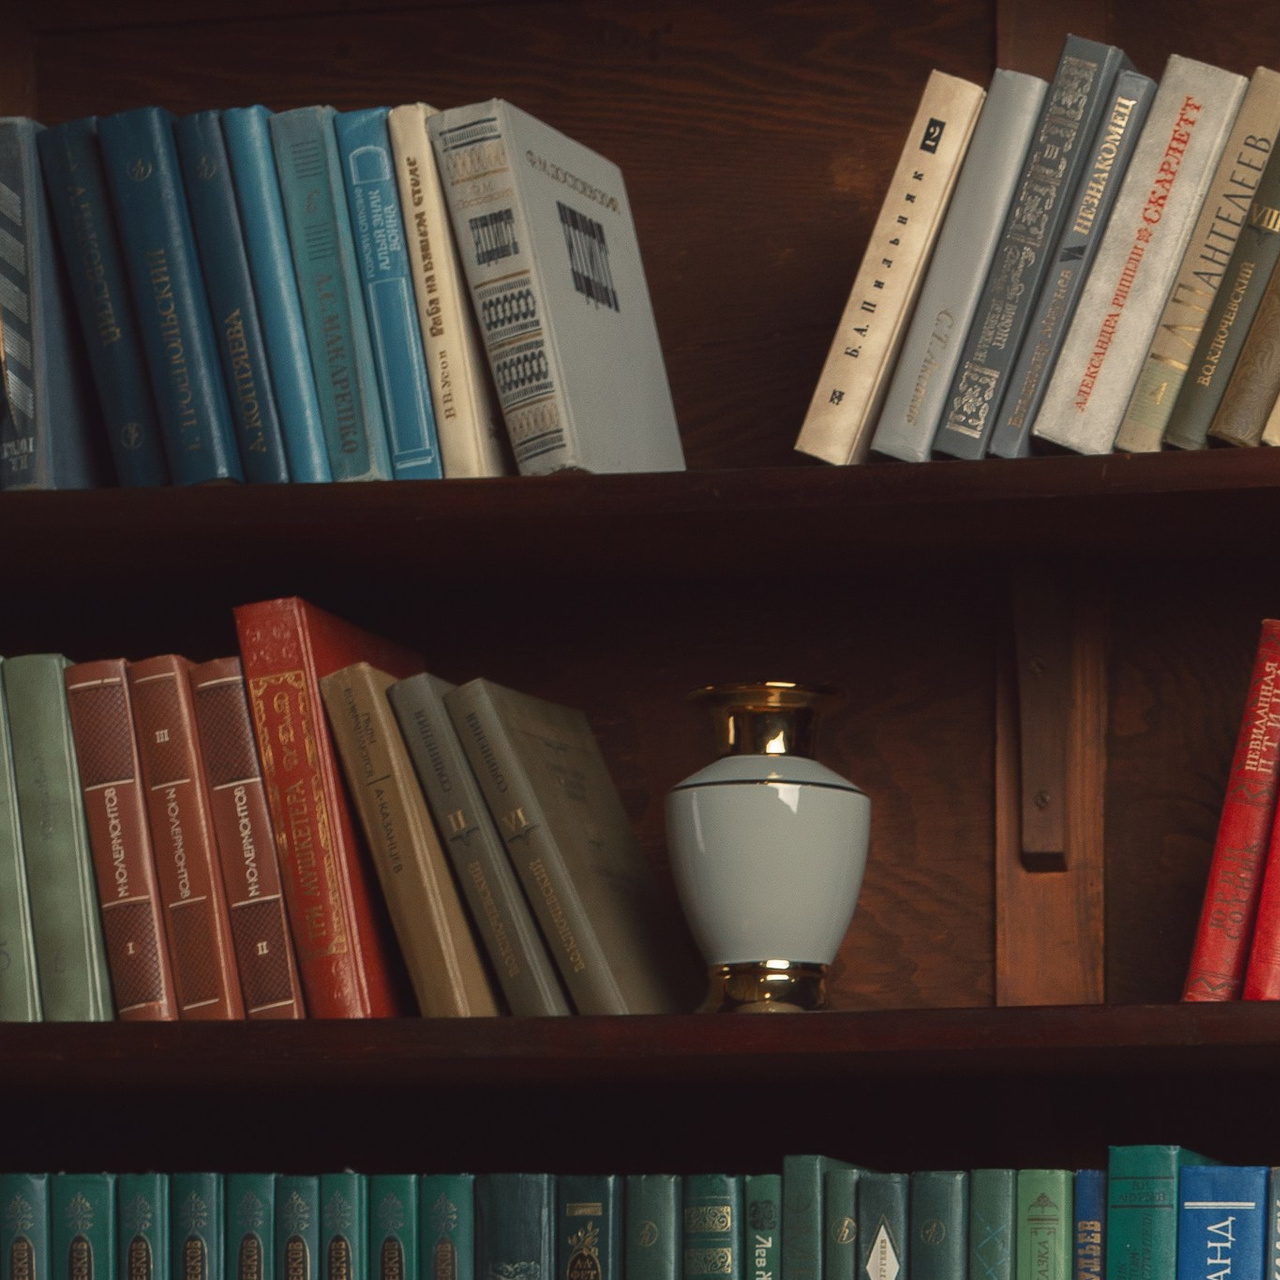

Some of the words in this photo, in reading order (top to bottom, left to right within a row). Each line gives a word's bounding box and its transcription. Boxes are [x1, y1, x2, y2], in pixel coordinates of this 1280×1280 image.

[923, 125, 942, 148] 2
[1073, 96, 1138, 236] НЕЗНАКОМЕЦ
[1141, 93, 1205, 226] СКАРЛЕТТ
[224, 308, 264, 429] КОПТЯЕВА
[1076, 307, 1122, 414] АЛЕКСАНДРА
[155, 729, 171, 743] III
[1245, 661, 1279, 771] НЕВИДАННАЯ
[255, 941, 271, 956] II
[754, 1233, 772, 1268] Лев
